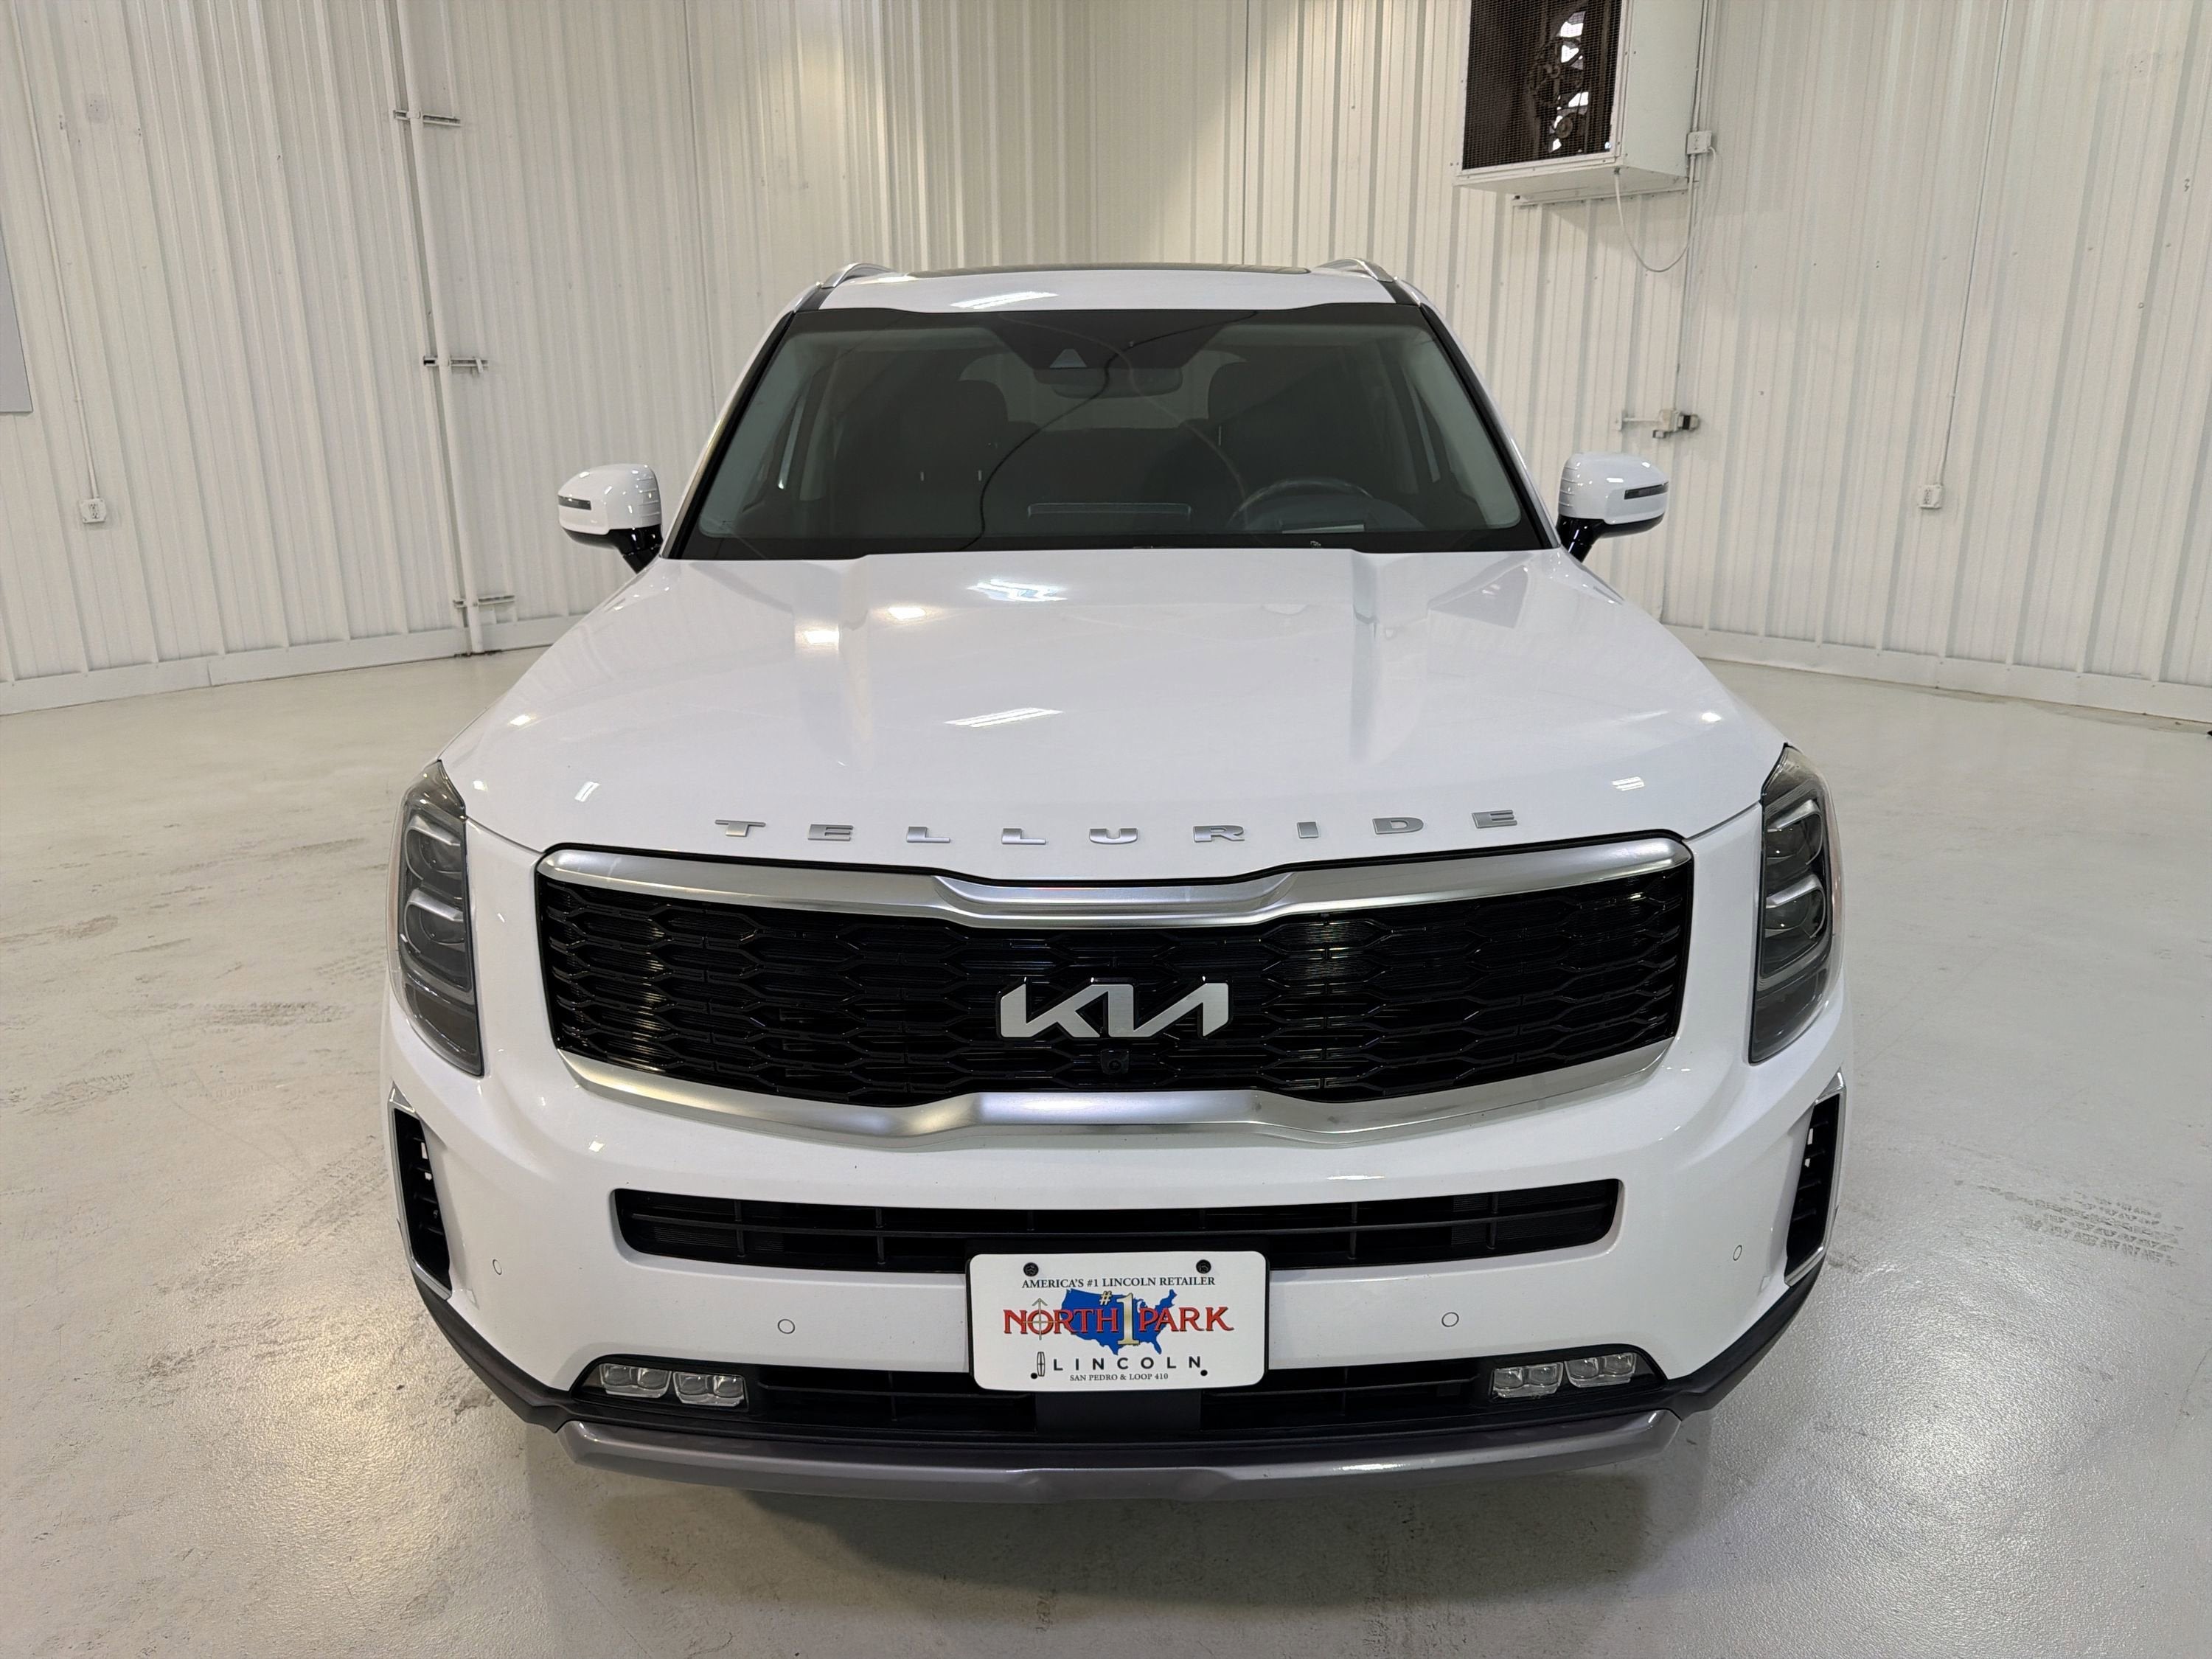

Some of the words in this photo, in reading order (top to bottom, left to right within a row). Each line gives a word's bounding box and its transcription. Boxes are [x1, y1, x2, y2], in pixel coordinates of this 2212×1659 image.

[715, 809, 1518, 845] TELLURIDE
[1021, 1276, 1084, 1289] AMERICA'S
[1086, 1277, 1099, 1287] #1
[1102, 1276, 1156, 1287] LINCOLN
[1159, 1275, 1216, 1286] RETAILER
[1004, 1308, 1119, 1335] NORTH
[1139, 1307, 1235, 1332] PARK
[1053, 1355, 1201, 1371] LINCOLN
[1128, 1373, 1153, 1381] LOOP
[1154, 1372, 1169, 1380] 410
